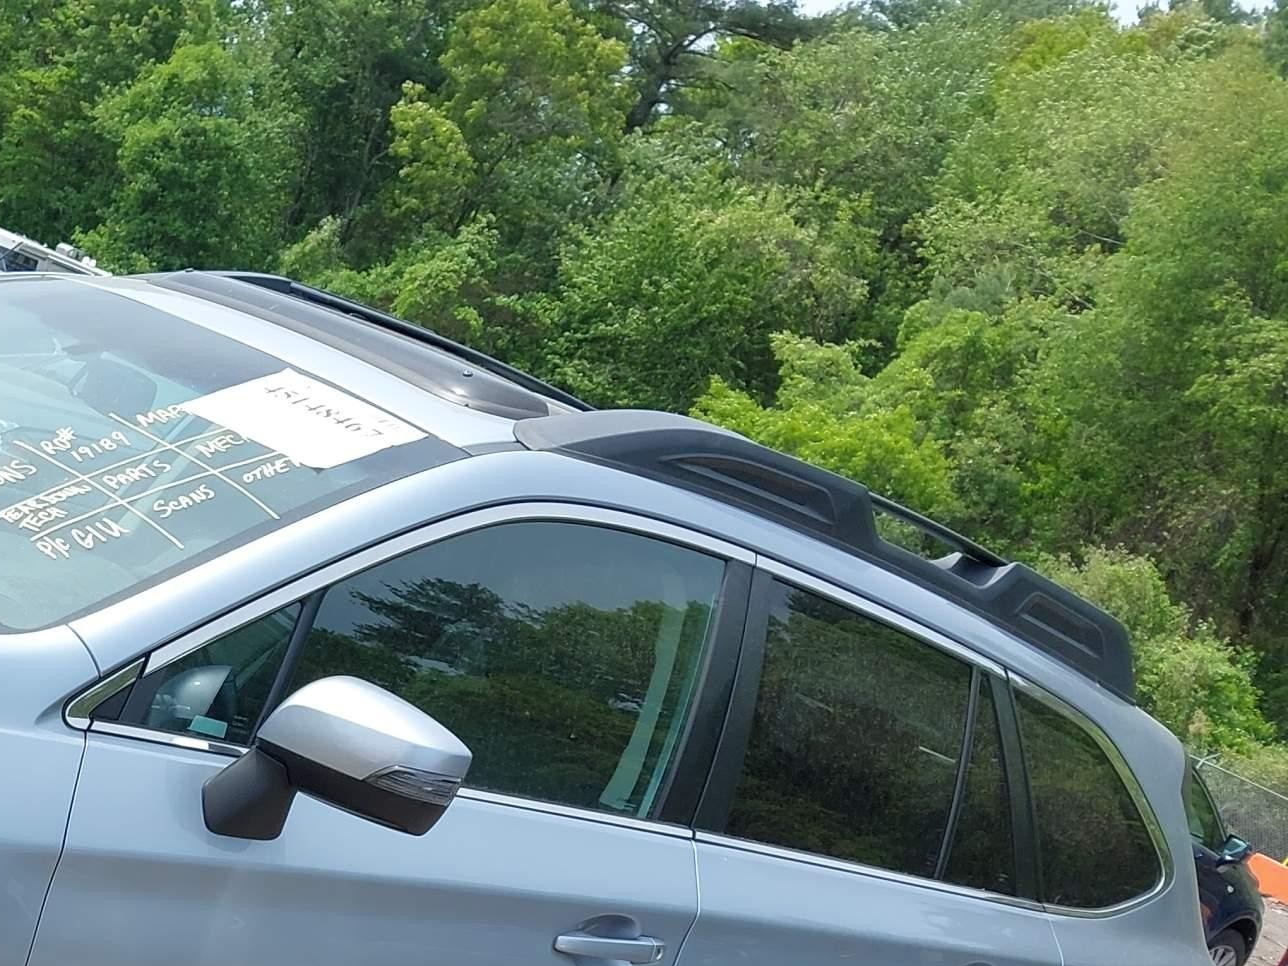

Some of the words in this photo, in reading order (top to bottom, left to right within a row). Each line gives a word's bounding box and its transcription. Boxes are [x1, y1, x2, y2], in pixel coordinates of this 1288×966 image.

[70, 431, 130, 463] 19189
[195, 434, 250, 458] MEC
[103, 460, 172, 489] PARTS
[242, 456, 301, 484] OTHE
[153, 484, 215, 518] SCANS
